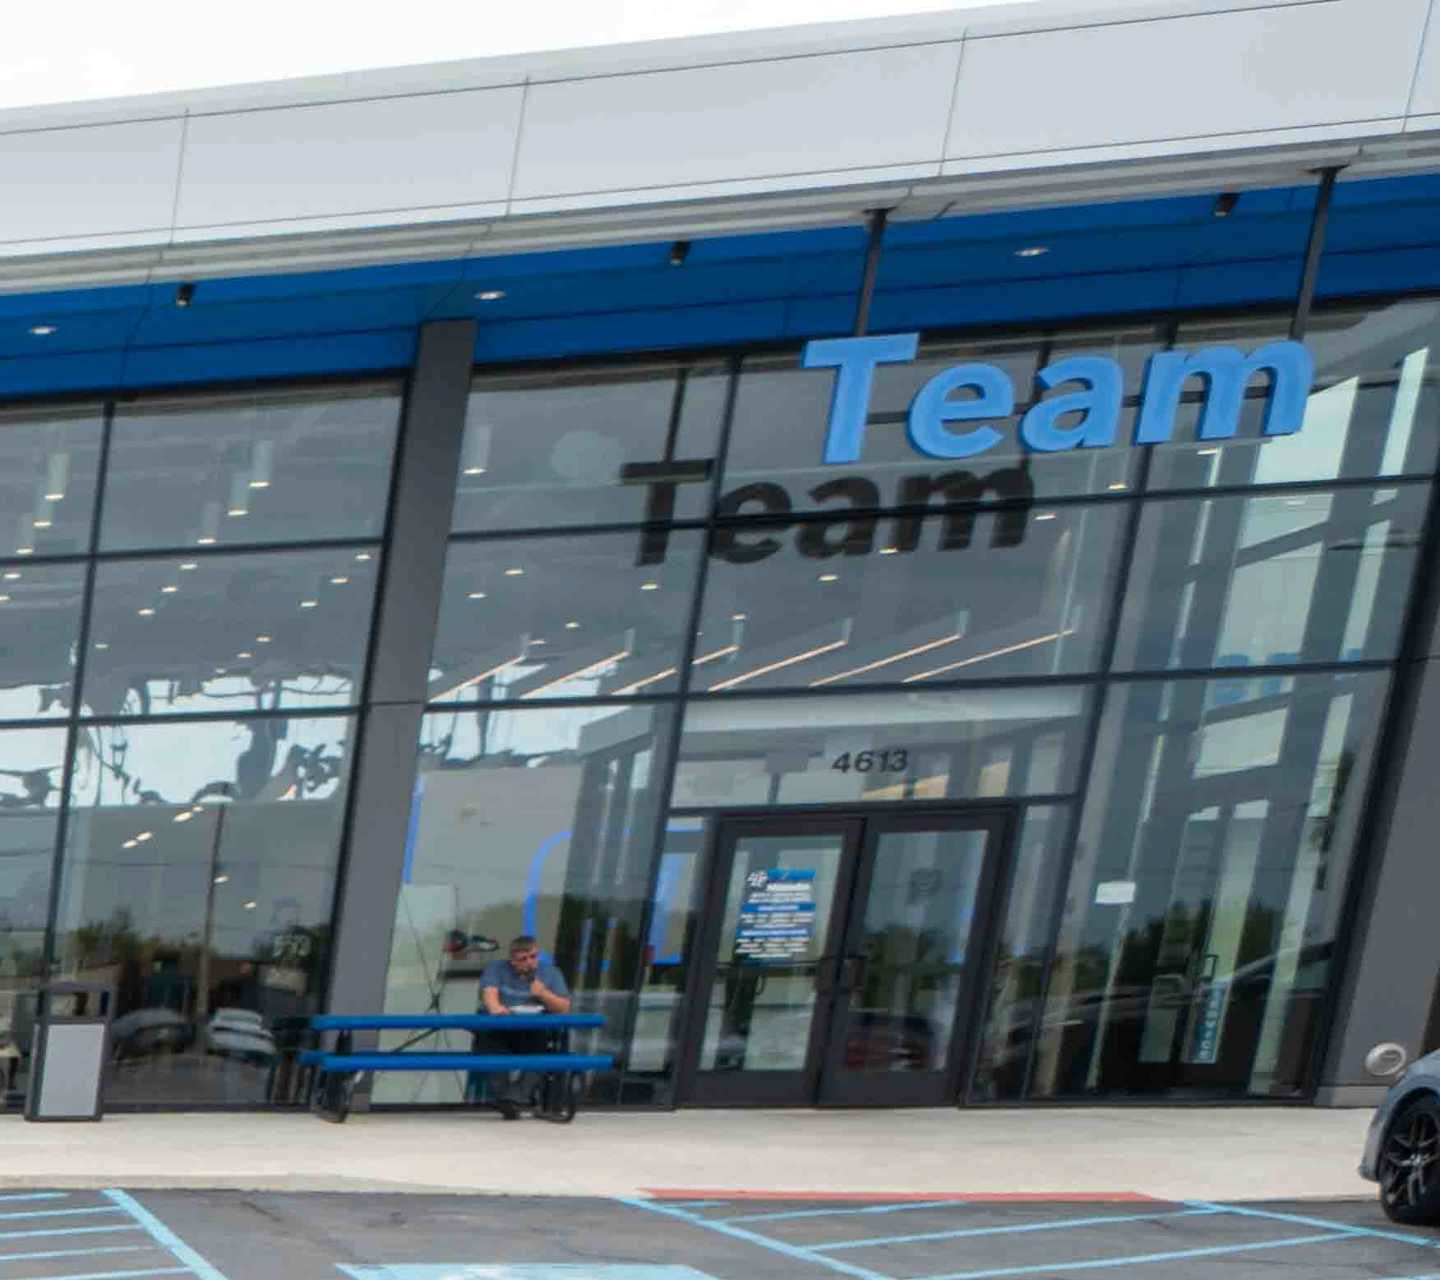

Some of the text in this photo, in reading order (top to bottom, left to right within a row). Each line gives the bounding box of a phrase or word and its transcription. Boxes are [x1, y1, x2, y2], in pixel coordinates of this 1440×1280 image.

[802, 332, 1315, 464] Team
[620, 459, 1034, 566] Team
[831, 749, 908, 774] 4613
